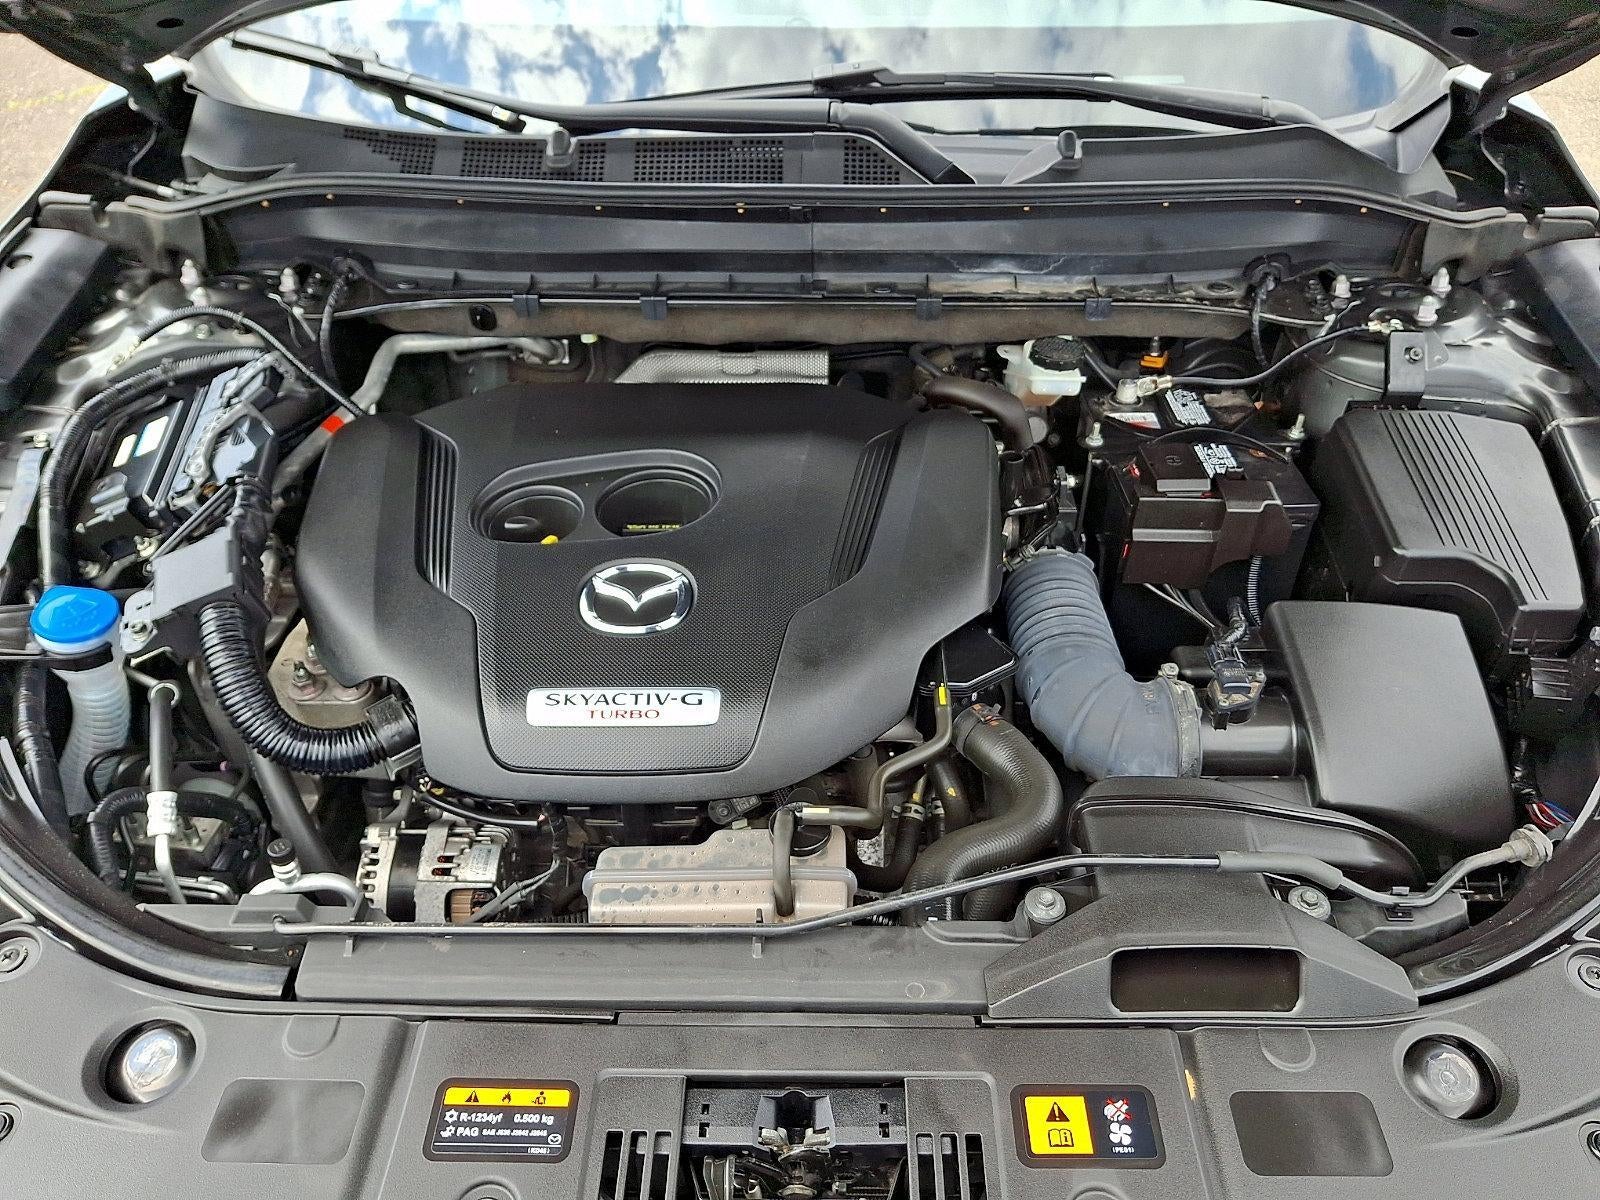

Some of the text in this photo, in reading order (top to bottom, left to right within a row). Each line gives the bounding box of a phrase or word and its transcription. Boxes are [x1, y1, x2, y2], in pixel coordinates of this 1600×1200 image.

[544, 692, 704, 706] SKYACTIV-G
[586, 708, 661, 720] TURBO
[459, 1112, 555, 1125] R-1234yf 0.500 kg
[456, 1126, 479, 1137] PAG
